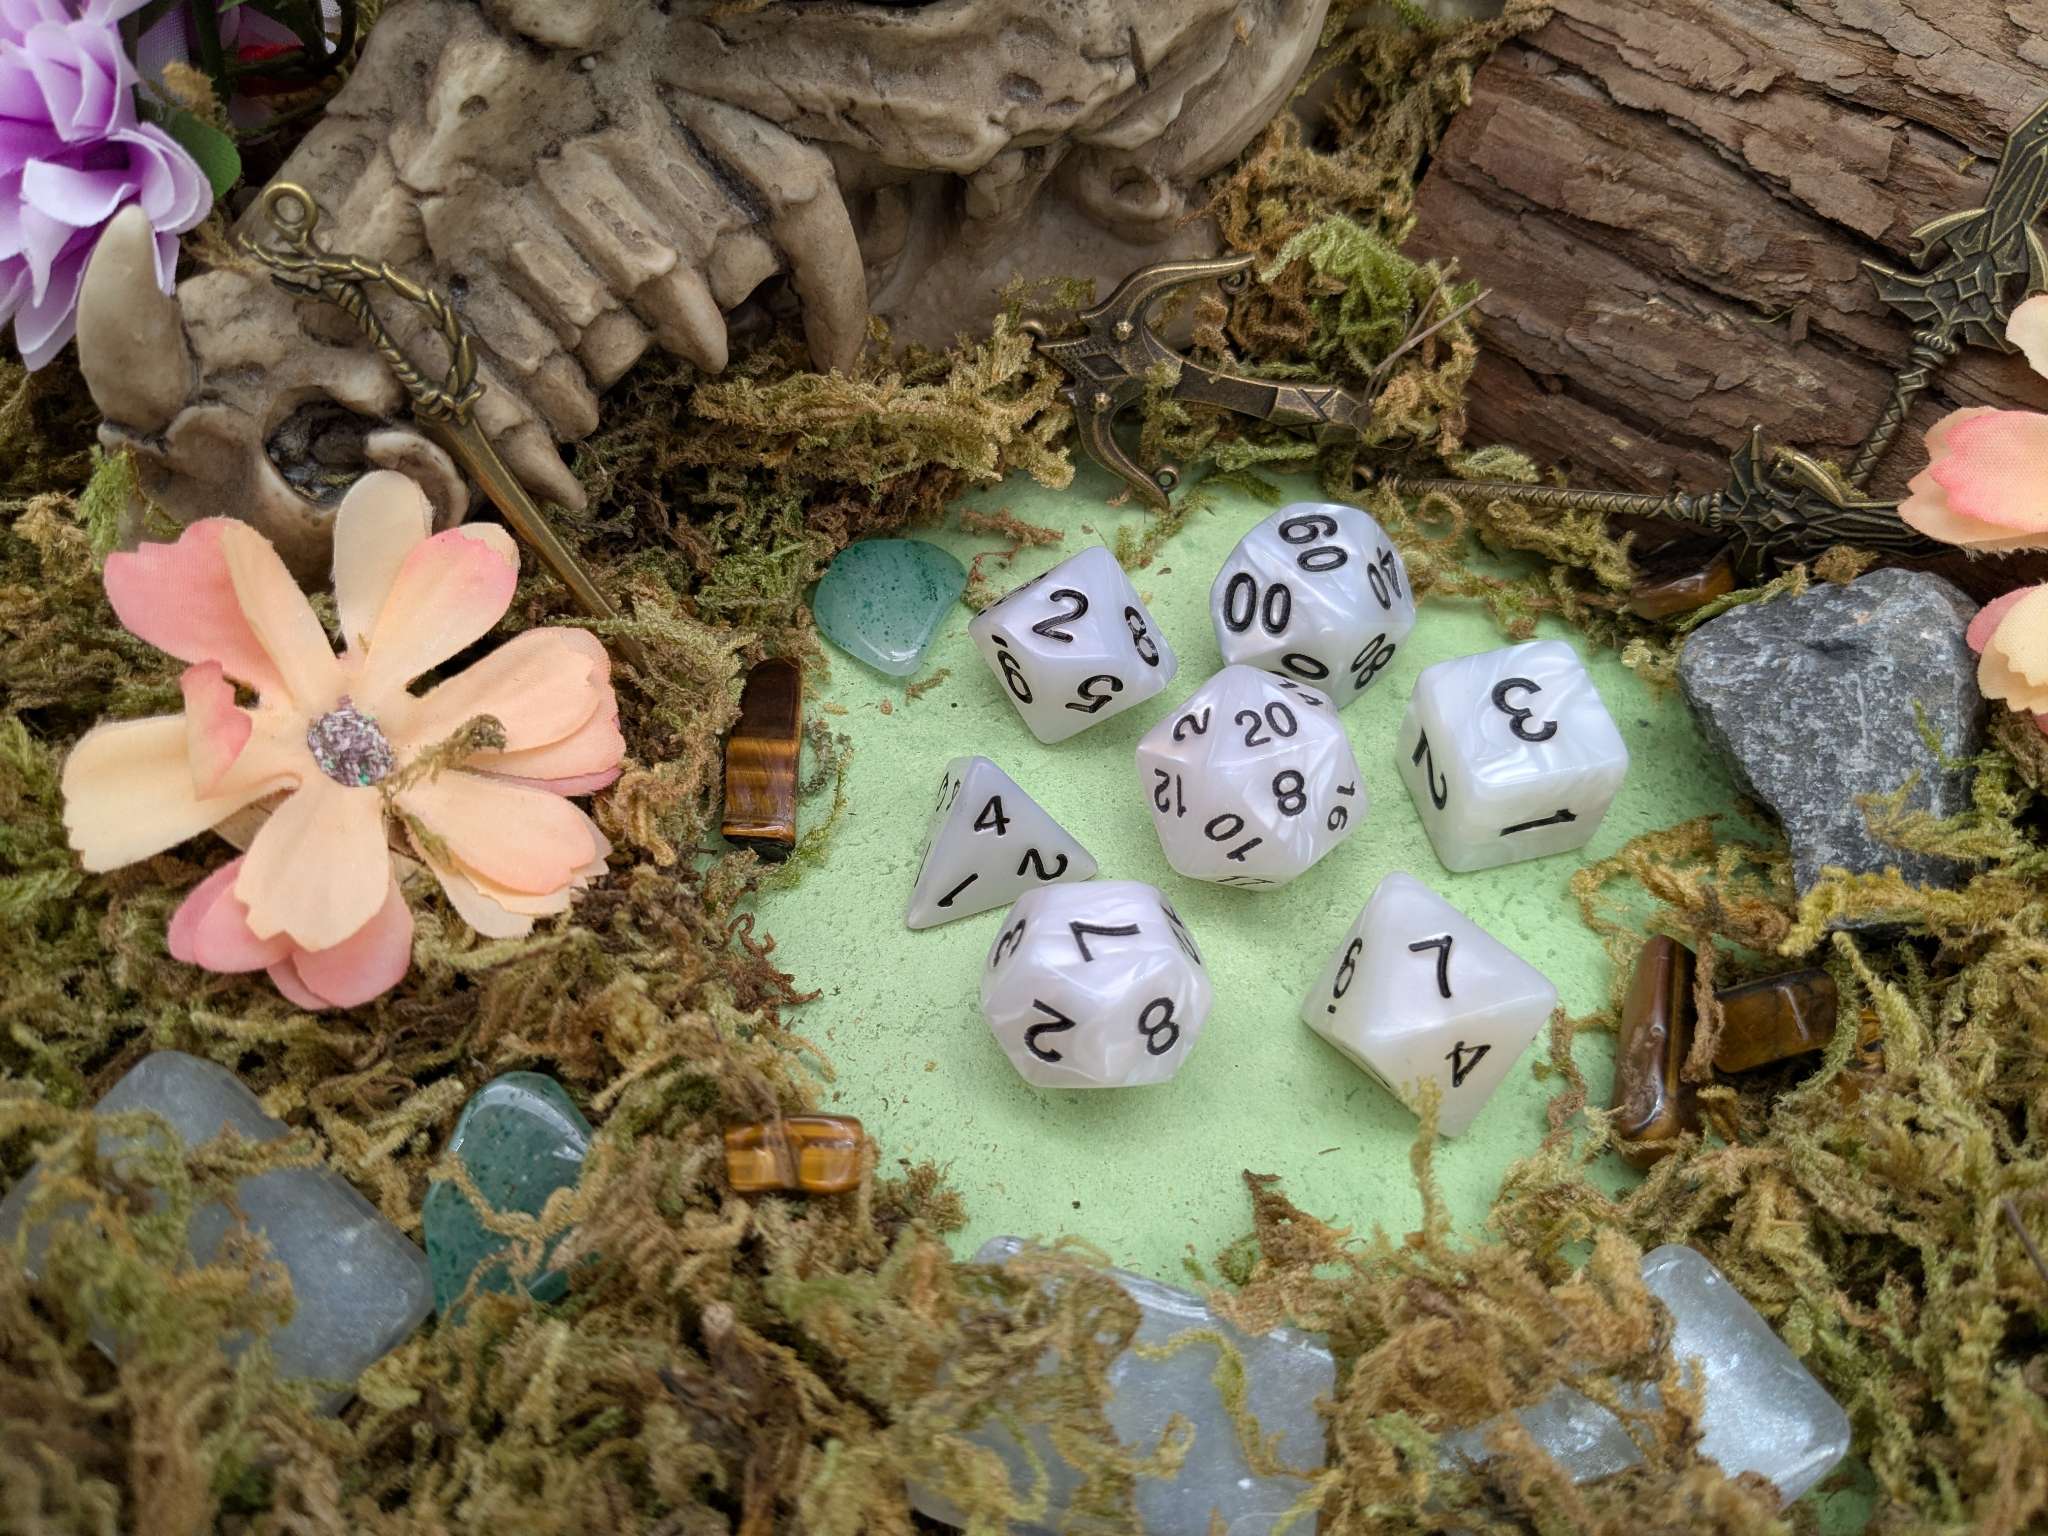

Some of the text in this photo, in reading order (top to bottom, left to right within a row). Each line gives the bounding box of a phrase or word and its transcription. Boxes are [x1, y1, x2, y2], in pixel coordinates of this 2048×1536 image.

[1031, 588, 1089, 644] 2
[1223, 572, 1292, 635] 00
[1124, 605, 1160, 667] 8
[1064, 674, 1124, 714] 5
[1490, 677, 1558, 743] 3
[1172, 706, 1212, 742] 2
[1234, 701, 1298, 748] 20
[1153, 767, 1187, 818] 12
[1271, 769, 1307, 817] 8
[1411, 727, 1448, 811] 2
[973, 794, 1011, 837] 4
[1203, 813, 1263, 862] 10
[1499, 808, 1577, 837] 1
[1016, 848, 1069, 881] 2
[936, 872, 979, 908] 1
[992, 918, 1027, 967] 3
[1068, 920, 1142, 963] 7
[1407, 934, 1453, 999] 7
[1023, 998, 1077, 1063] 2
[1138, 996, 1180, 1056] 8
[1444, 1040, 1492, 1088] 4
